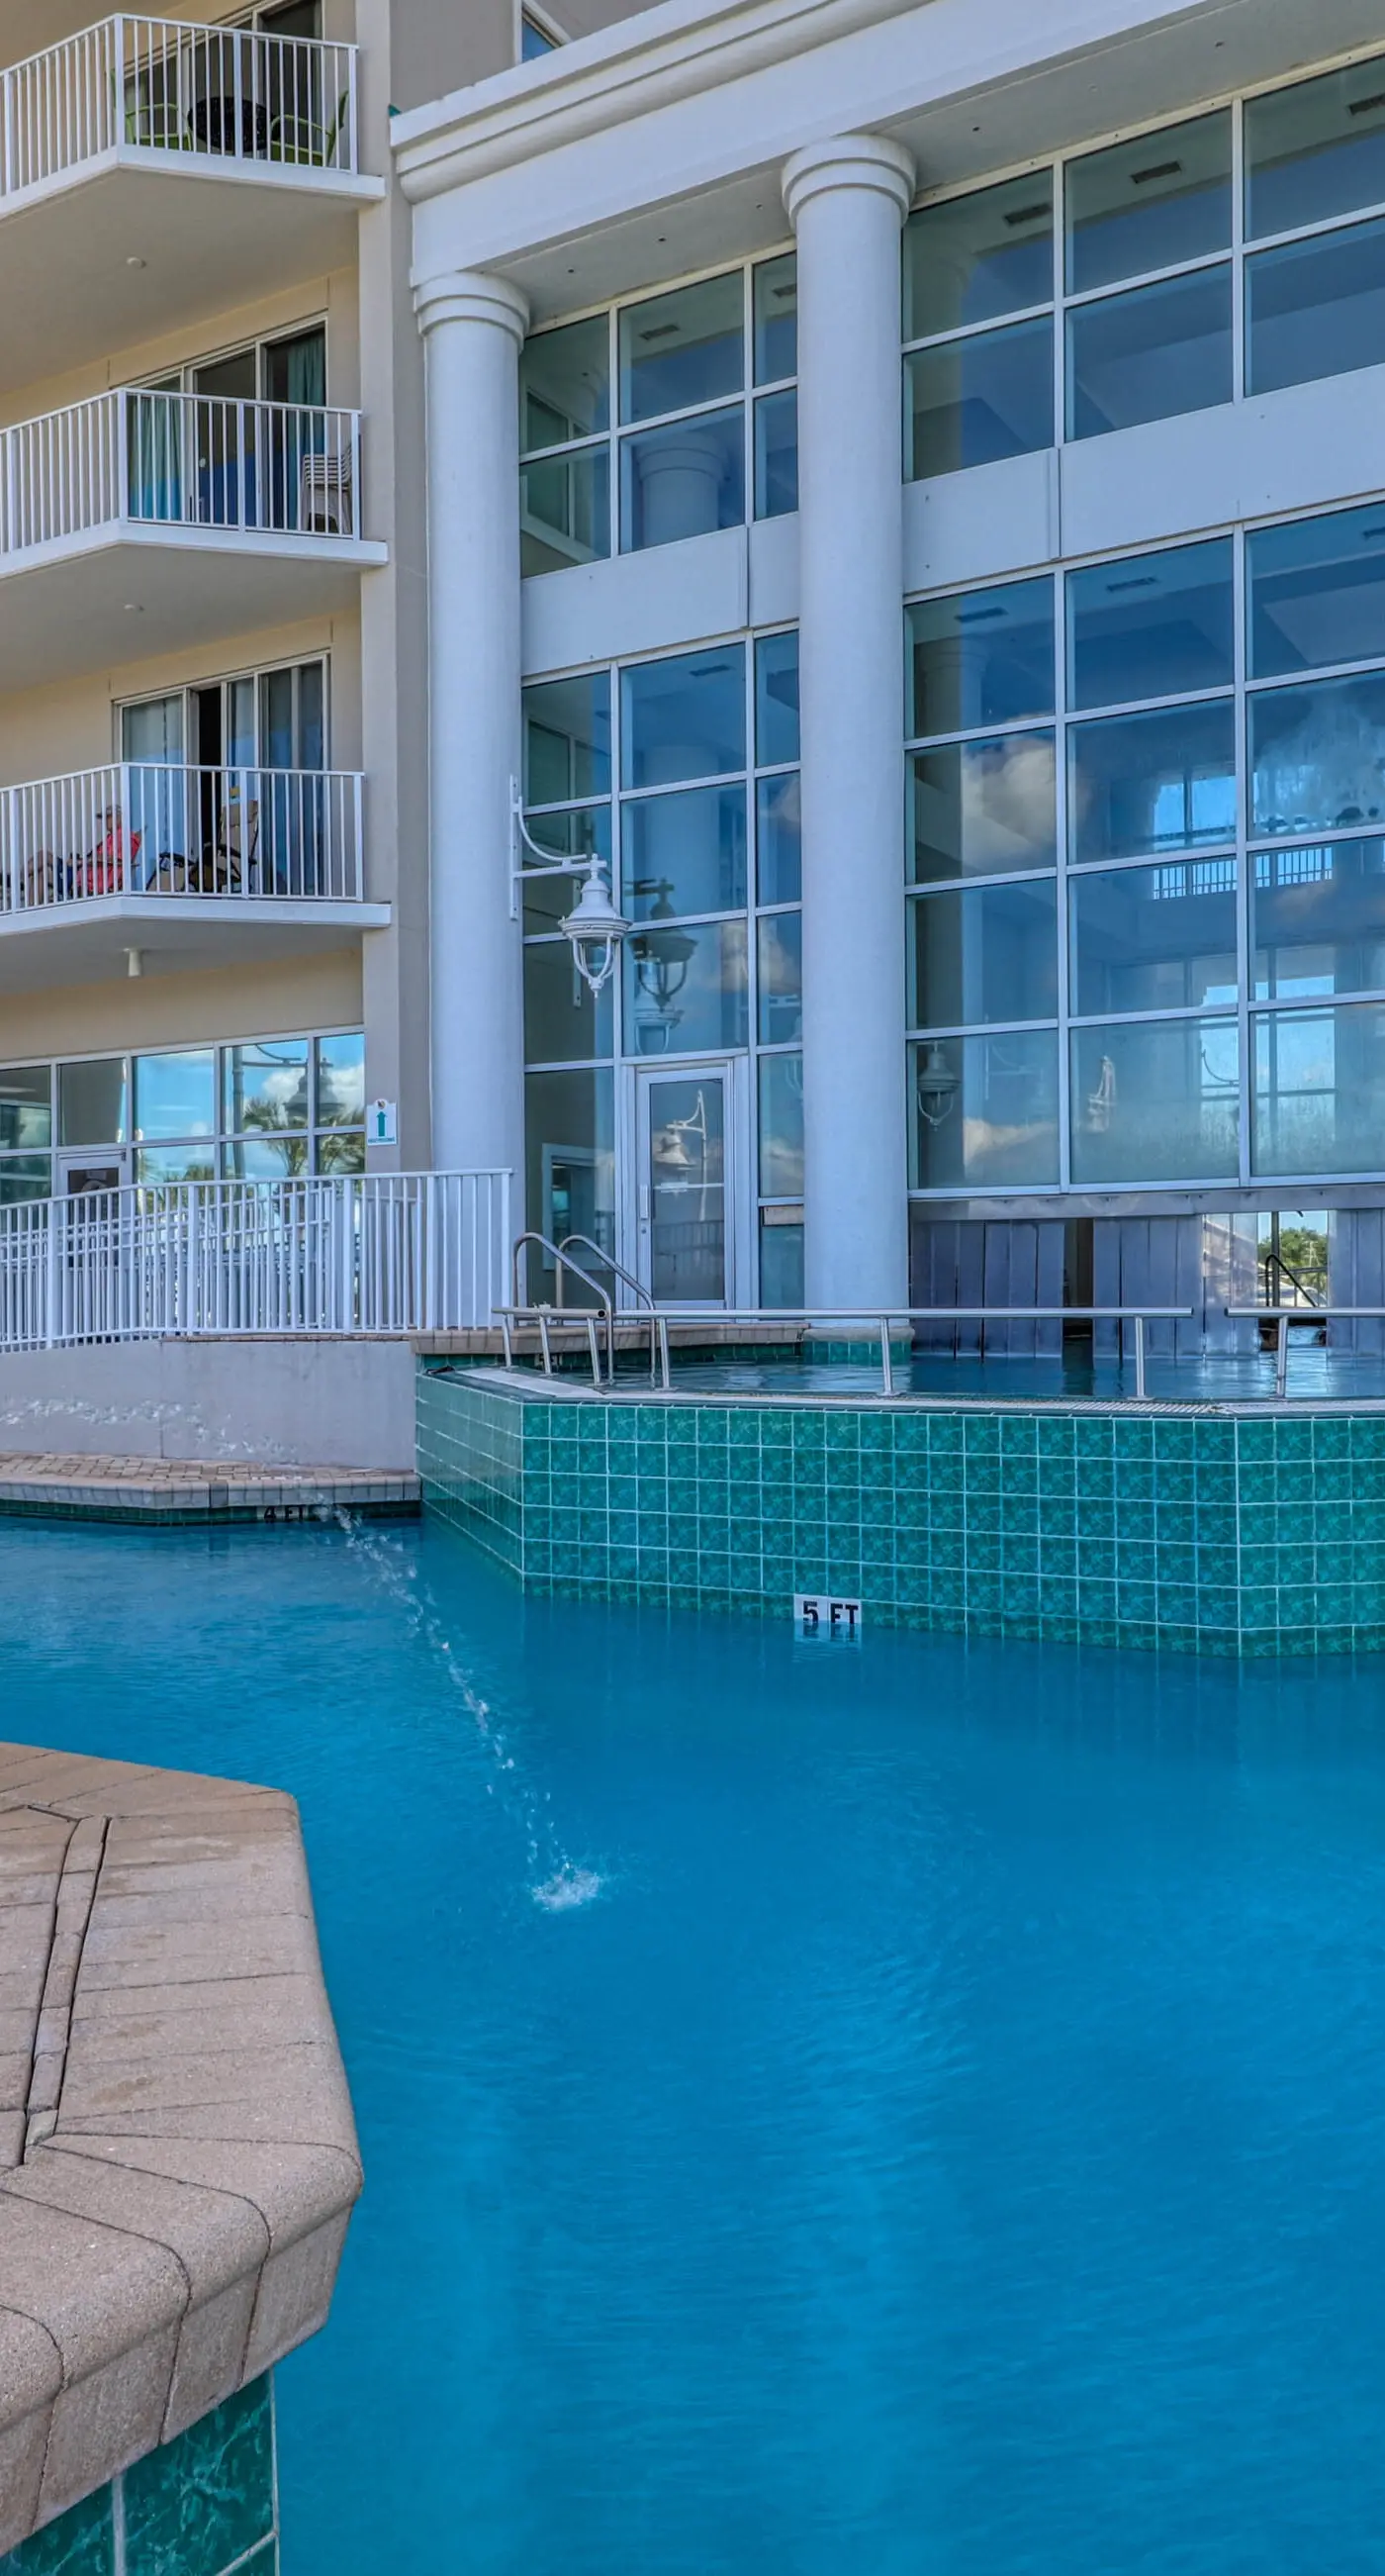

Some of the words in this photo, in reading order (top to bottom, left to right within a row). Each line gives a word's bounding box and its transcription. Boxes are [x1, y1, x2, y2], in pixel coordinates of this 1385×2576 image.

[264, 1505, 276, 1519] 4
[802, 1600, 819, 1623] 5
[830, 1602, 859, 1624] FT
